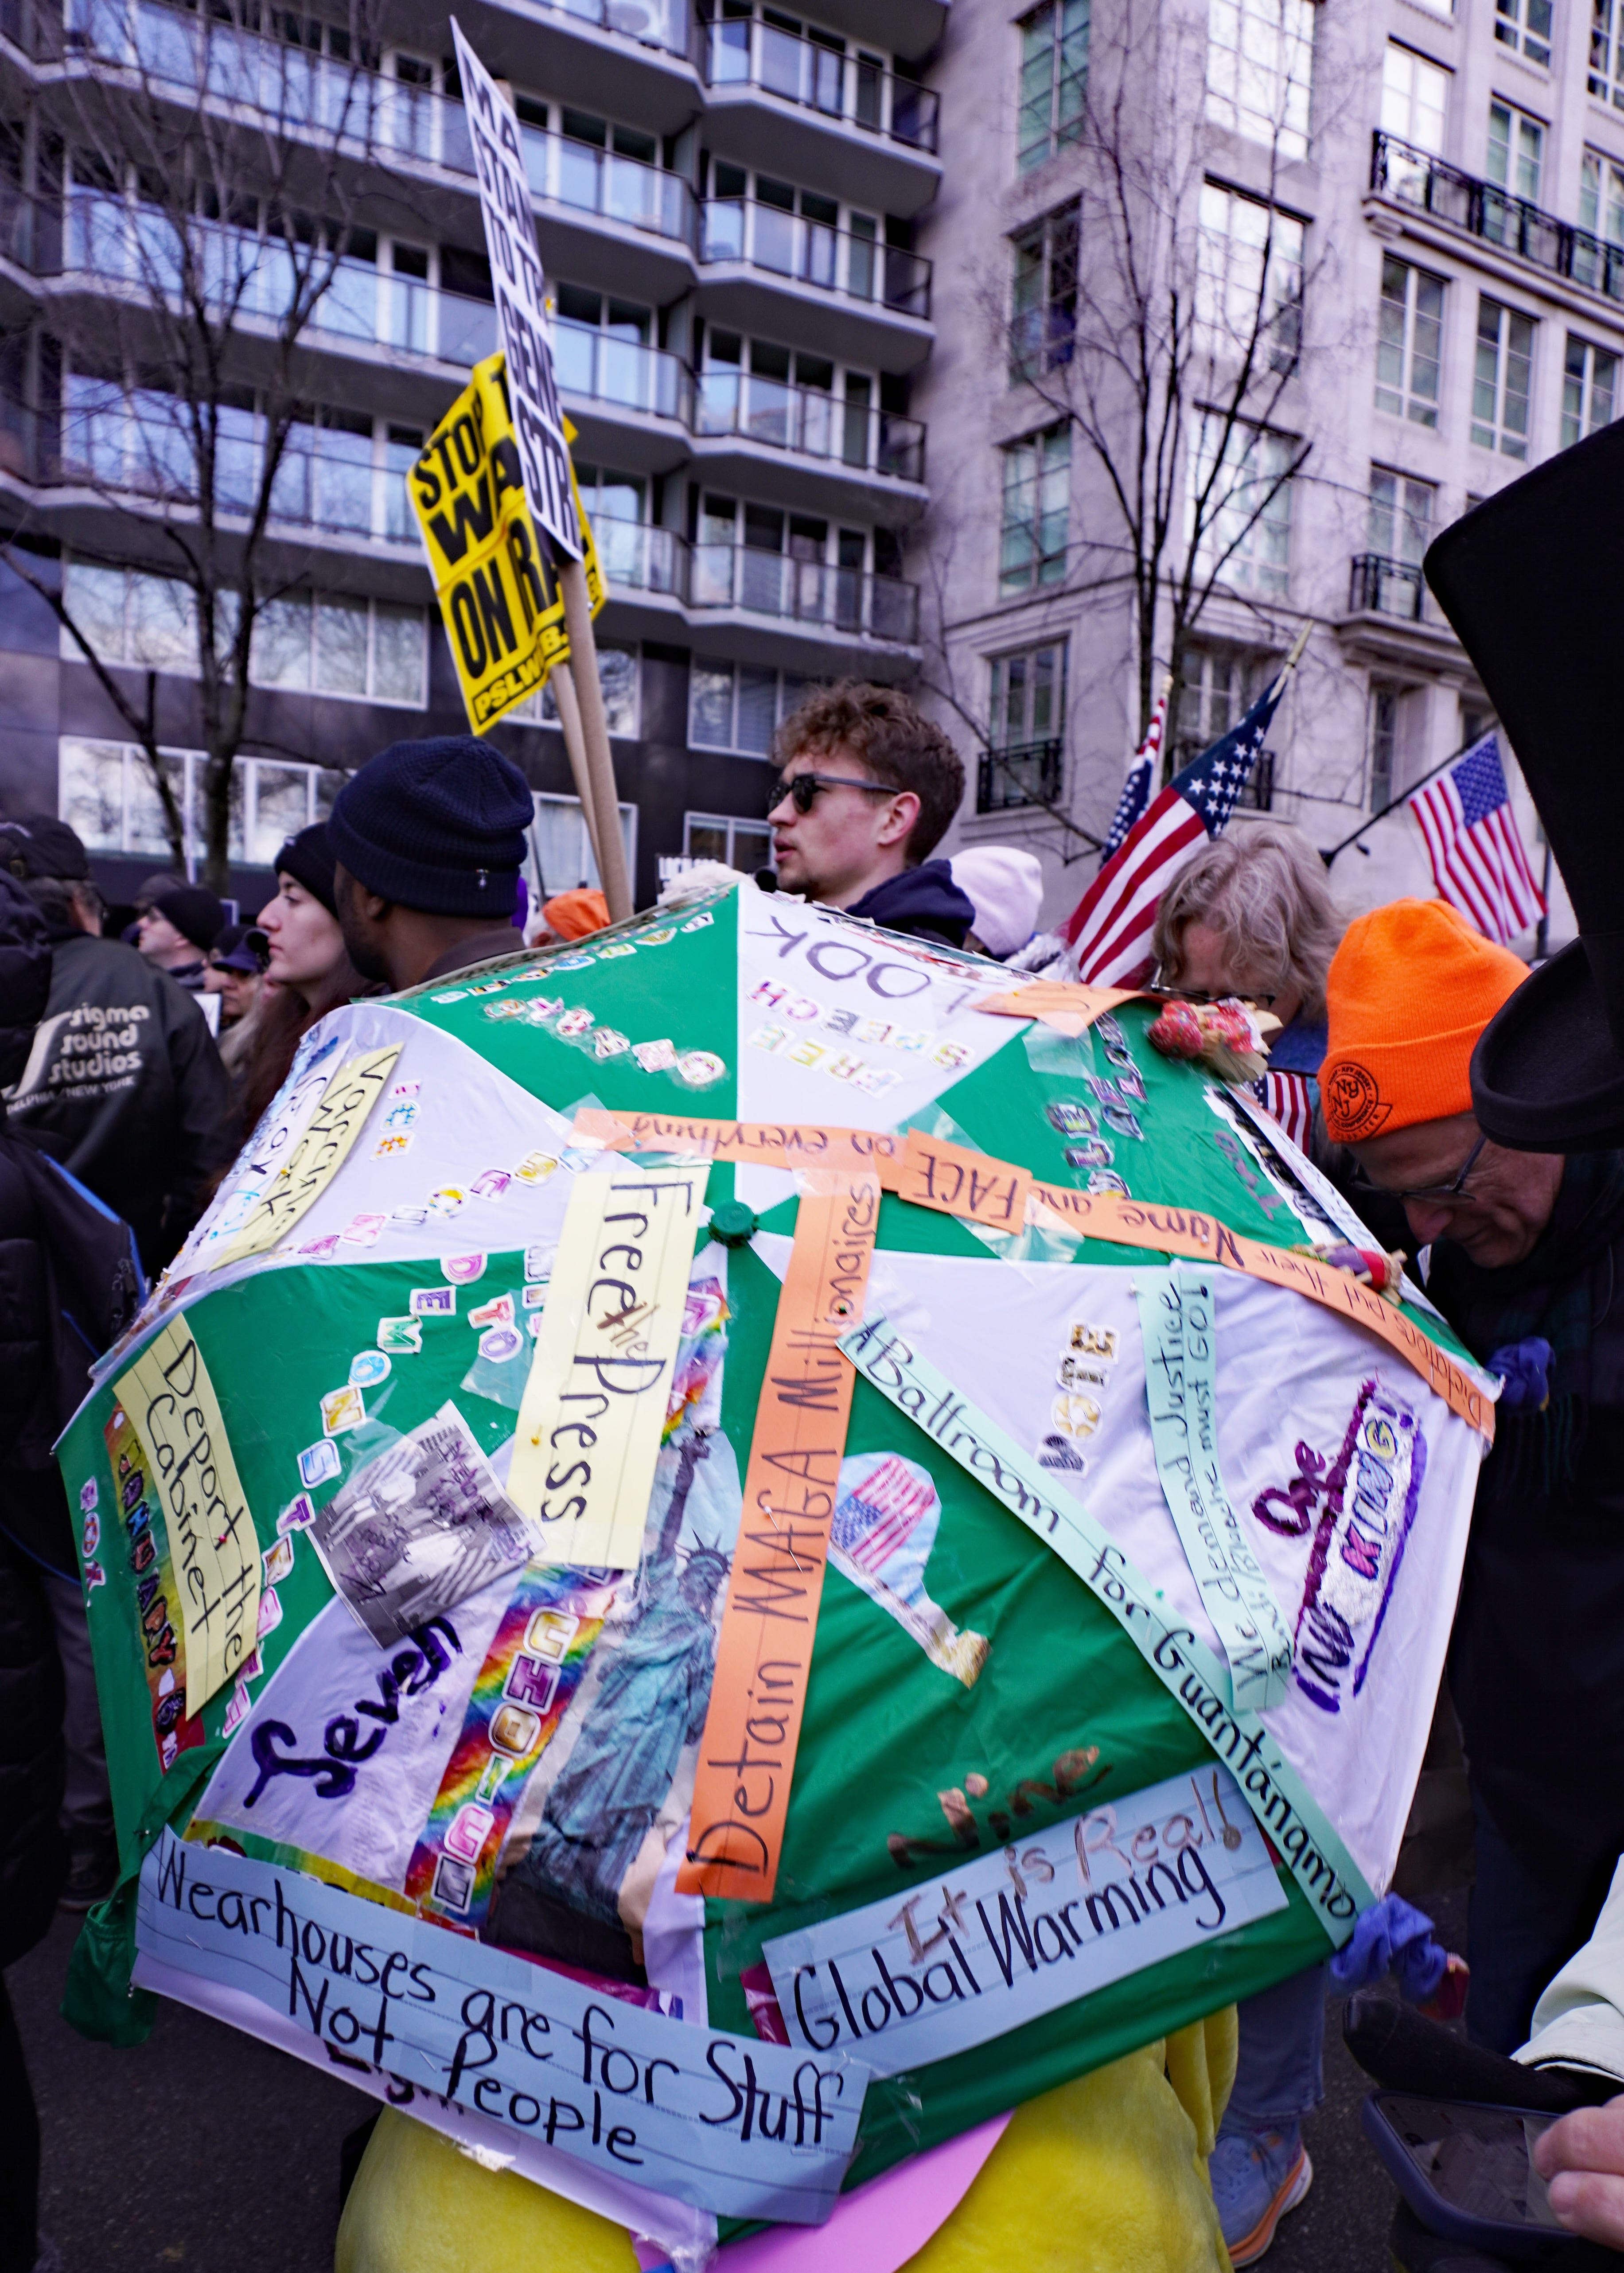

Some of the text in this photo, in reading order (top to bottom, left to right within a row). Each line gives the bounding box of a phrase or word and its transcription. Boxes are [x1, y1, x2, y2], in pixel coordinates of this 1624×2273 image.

[413, 389, 486, 510] STOP
[518, 395, 581, 553] STR
[428, 436, 524, 566] WA
[451, 557, 518, 679] ON
[745, 915, 978, 1013] LOOK
[60, 1023, 139, 1055] sound
[70, 1002, 150, 1031] sigma
[748, 981, 968, 1070] SPEECH
[751, 1024, 895, 1093] FREE
[48, 1050, 144, 1084] studios
[66, 1084, 98, 1097] NEW
[634, 1114, 828, 1154] everything
[852, 1133, 896, 1156] on
[914, 1153, 1020, 1222] FACE
[1118, 1203, 1244, 1268] Name
[588, 1181, 694, 1316] Free
[1256, 1249, 1328, 1297] their
[472, 1299, 518, 1358] TO
[596, 1301, 661, 1361] the
[851, 1318, 886, 1354] A
[1184, 1283, 1211, 1362] GO!
[1344, 1282, 1386, 1322] put
[540, 1354, 667, 1523] Press
[866, 1335, 1060, 1534] Ballroom
[1038, 1323, 1116, 1472] VOTE
[1188, 1379, 1213, 1453] must
[147, 1393, 221, 1634] Cabinet
[165, 1339, 256, 1675] Deport the
[689, 1182, 875, 1877] Detain MAGA Millionaires
[1151, 1281, 1267, 1693] We demand Justice
[1088, 1544, 1151, 1619] for
[243, 1615, 463, 1808] Seven
[436, 1611, 575, 1911] CHOICE
[886, 1769, 1242, 1966] It is Real!
[151, 1830, 436, 2002] Wearhouses
[460, 1990, 553, 2060] are
[572, 2004, 680, 2103] for
[699, 2039, 844, 2147] Stuff
[794, 1845, 1227, 2052] Global Warming
[290, 1957, 394, 2065] Not
[441, 2029, 644, 2165] People
